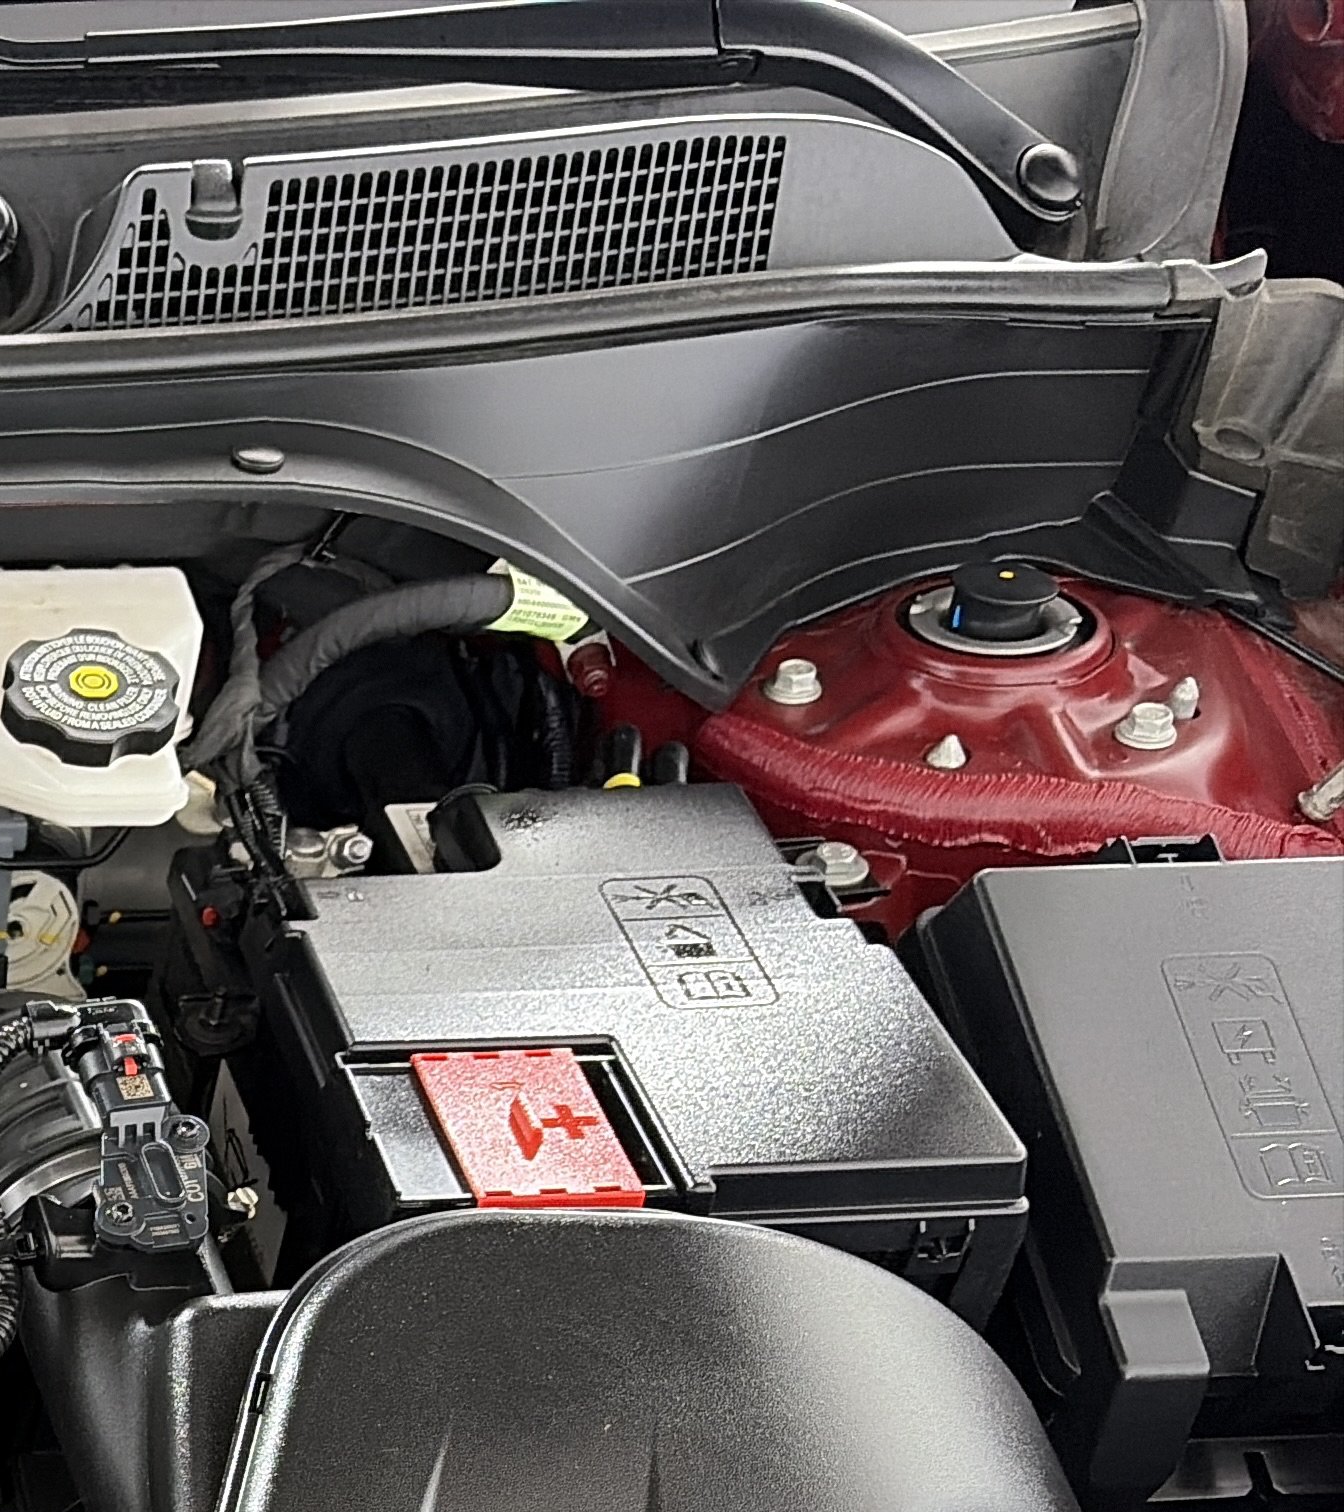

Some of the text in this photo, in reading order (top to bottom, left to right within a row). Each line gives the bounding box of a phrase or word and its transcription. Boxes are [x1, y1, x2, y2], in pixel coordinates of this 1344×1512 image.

[35, 701, 63, 720] FLUID
[60, 714, 91, 729] FROM
[90, 720, 99, 729] A
[99, 716, 137, 730] SEALED
[87, 701, 119, 712] CLEAN
